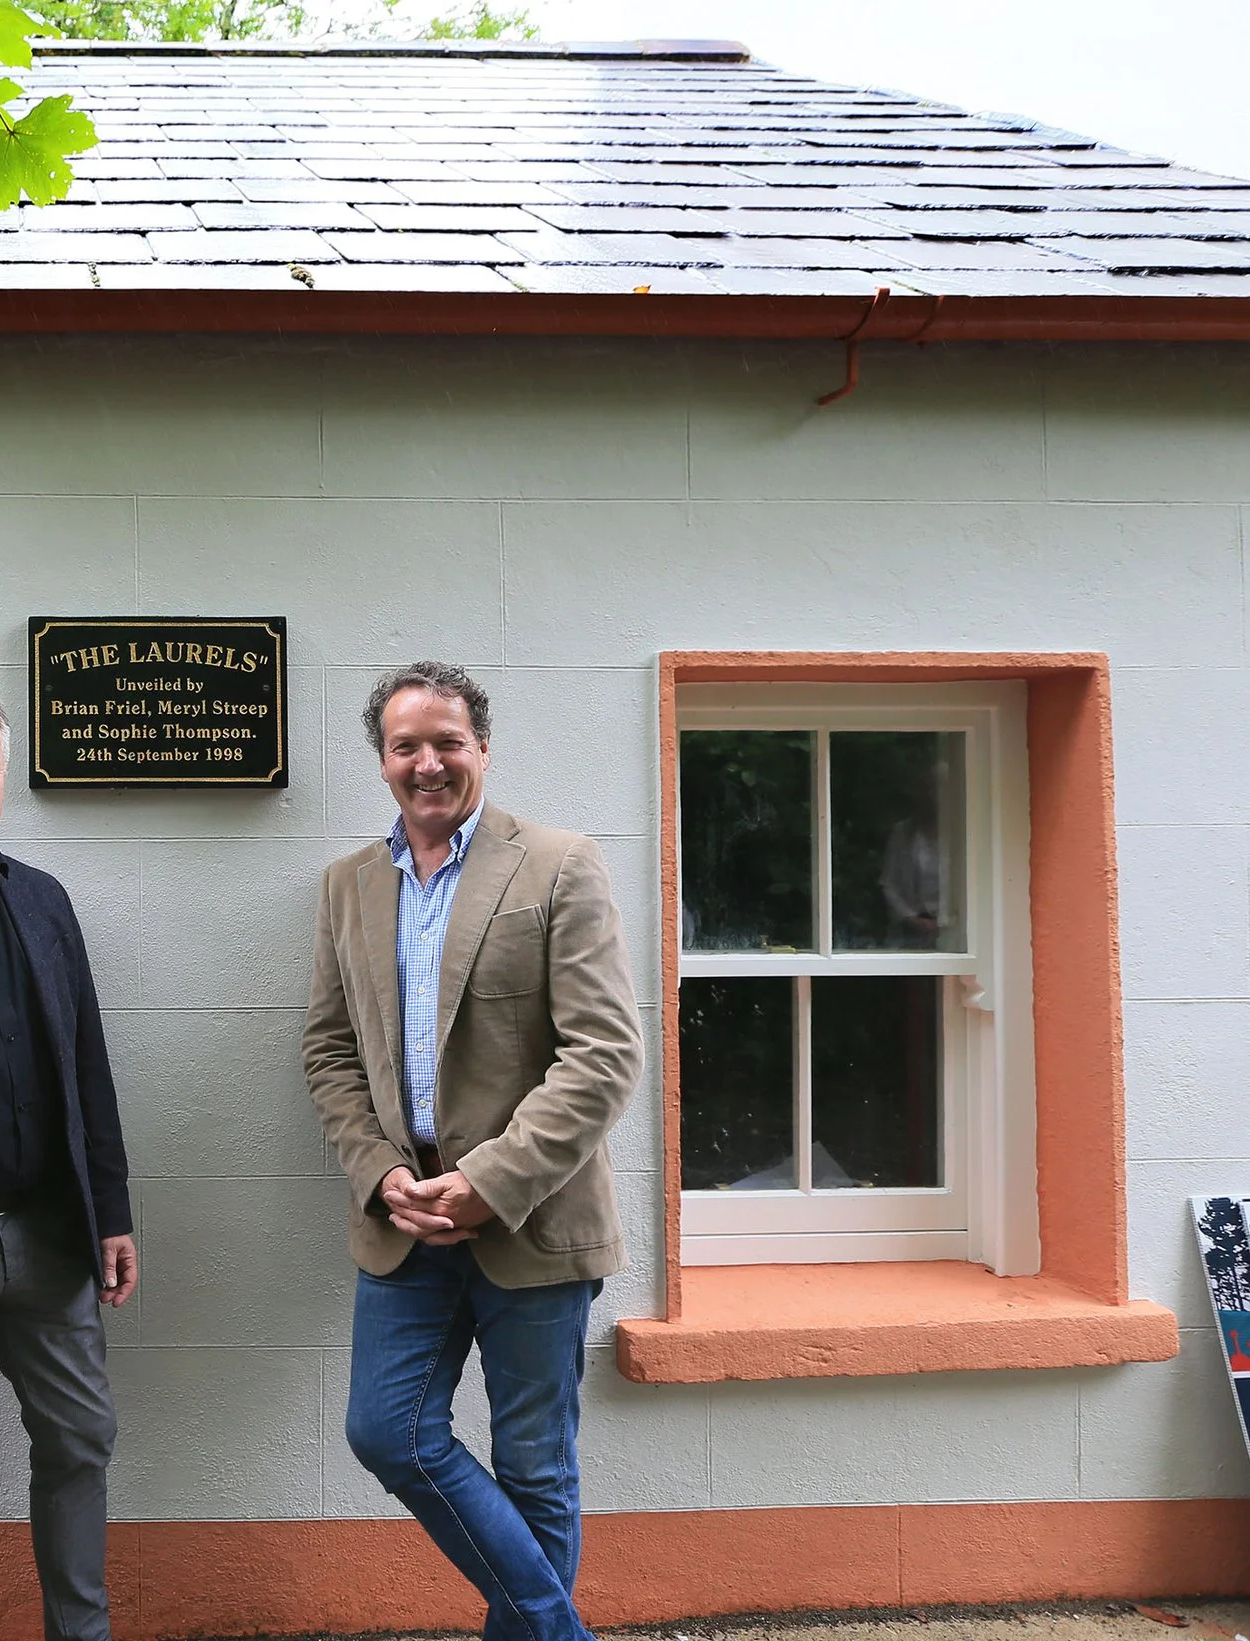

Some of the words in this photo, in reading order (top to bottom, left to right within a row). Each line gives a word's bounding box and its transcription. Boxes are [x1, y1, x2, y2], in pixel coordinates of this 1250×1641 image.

[50, 643, 120, 673] "THE
[128, 641, 269, 673] LAURELS"
[115, 677, 182, 692] Unveiled
[186, 677, 204, 694] by
[50, 700, 99, 715] Brian
[104, 700, 152, 717] Friel,
[157, 700, 207, 718] Meryl
[212, 700, 268, 718] Streep
[61, 724, 93, 739] and
[98, 724, 157, 742] Sophie
[162, 724, 257, 742] Thompson.
[76, 748, 112, 762] 24th
[117, 747, 200, 764] September
[205, 747, 243, 761] 1998
